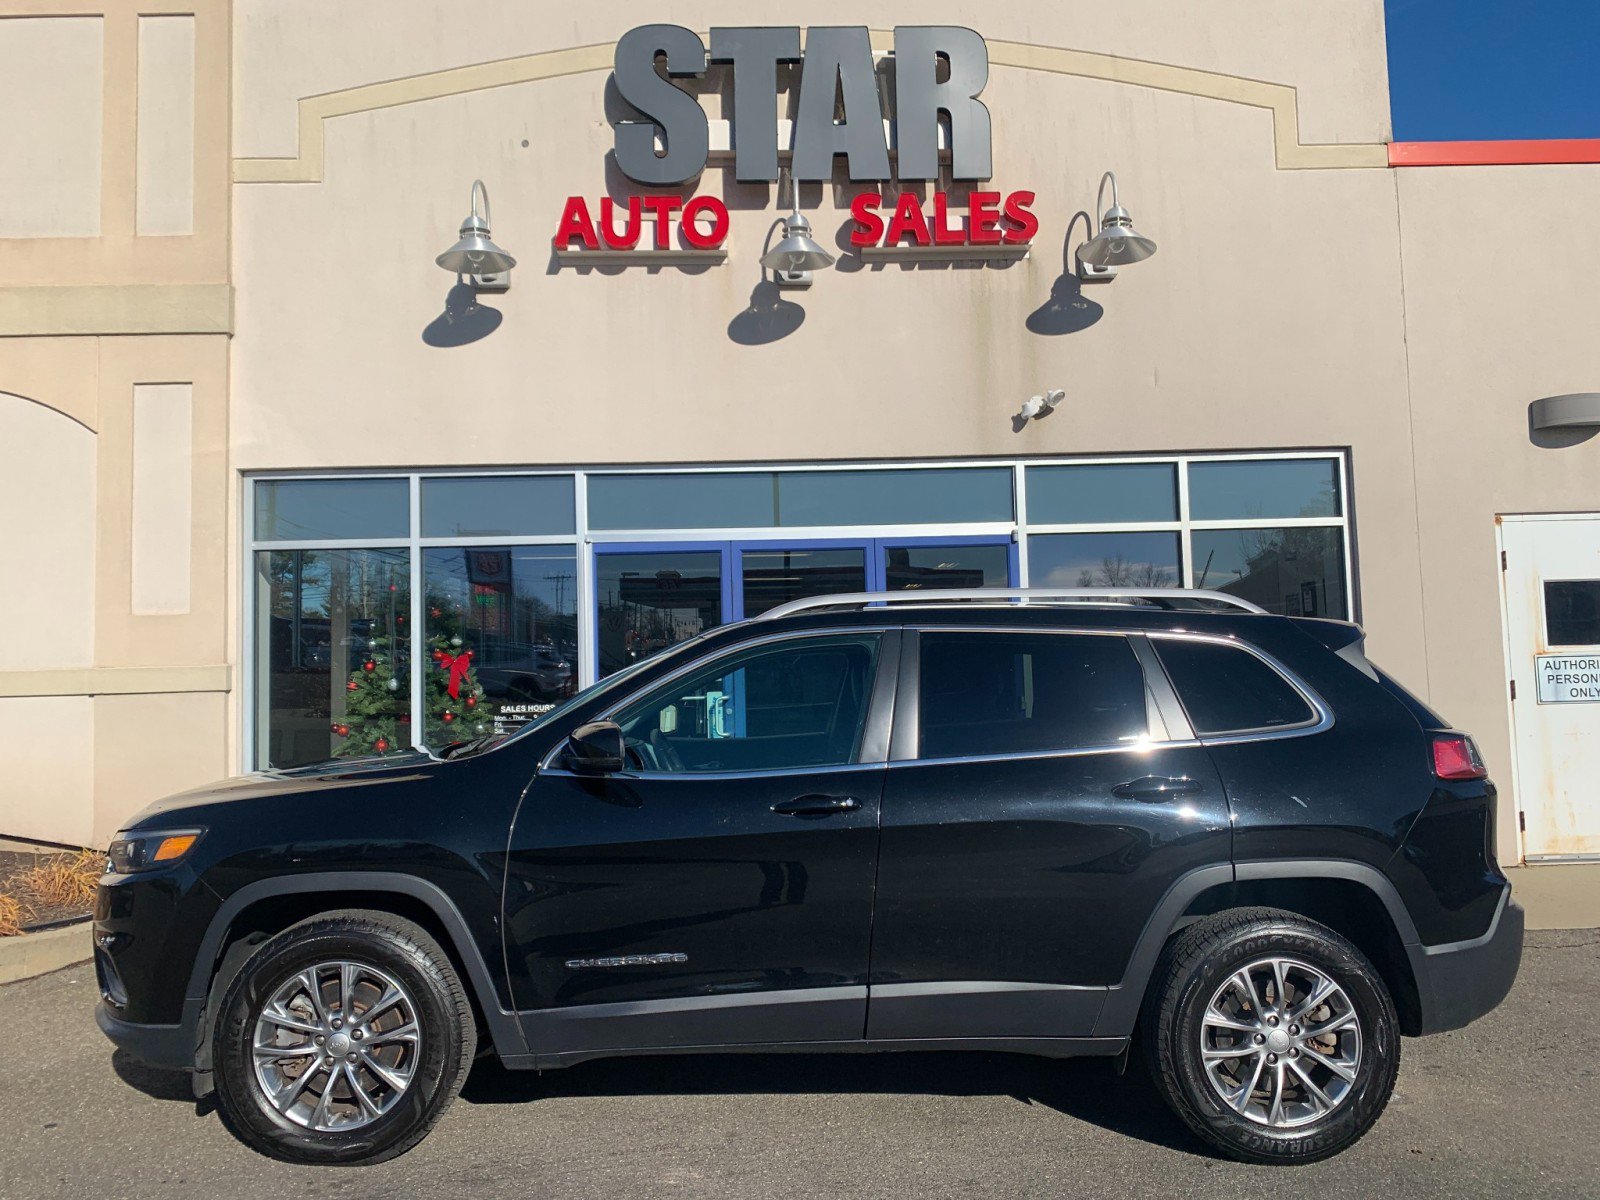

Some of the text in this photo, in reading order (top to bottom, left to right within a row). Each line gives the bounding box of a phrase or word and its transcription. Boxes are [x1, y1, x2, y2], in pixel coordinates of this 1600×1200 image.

[614, 24, 992, 186] STAR
[554, 190, 1039, 251] AUTO SALES
[1544, 659, 1600, 670] AUTHORI
[1547, 673, 1600, 684] PERSON
[1570, 687, 1600, 698] ONLY
[500, 705, 526, 713] SALES
